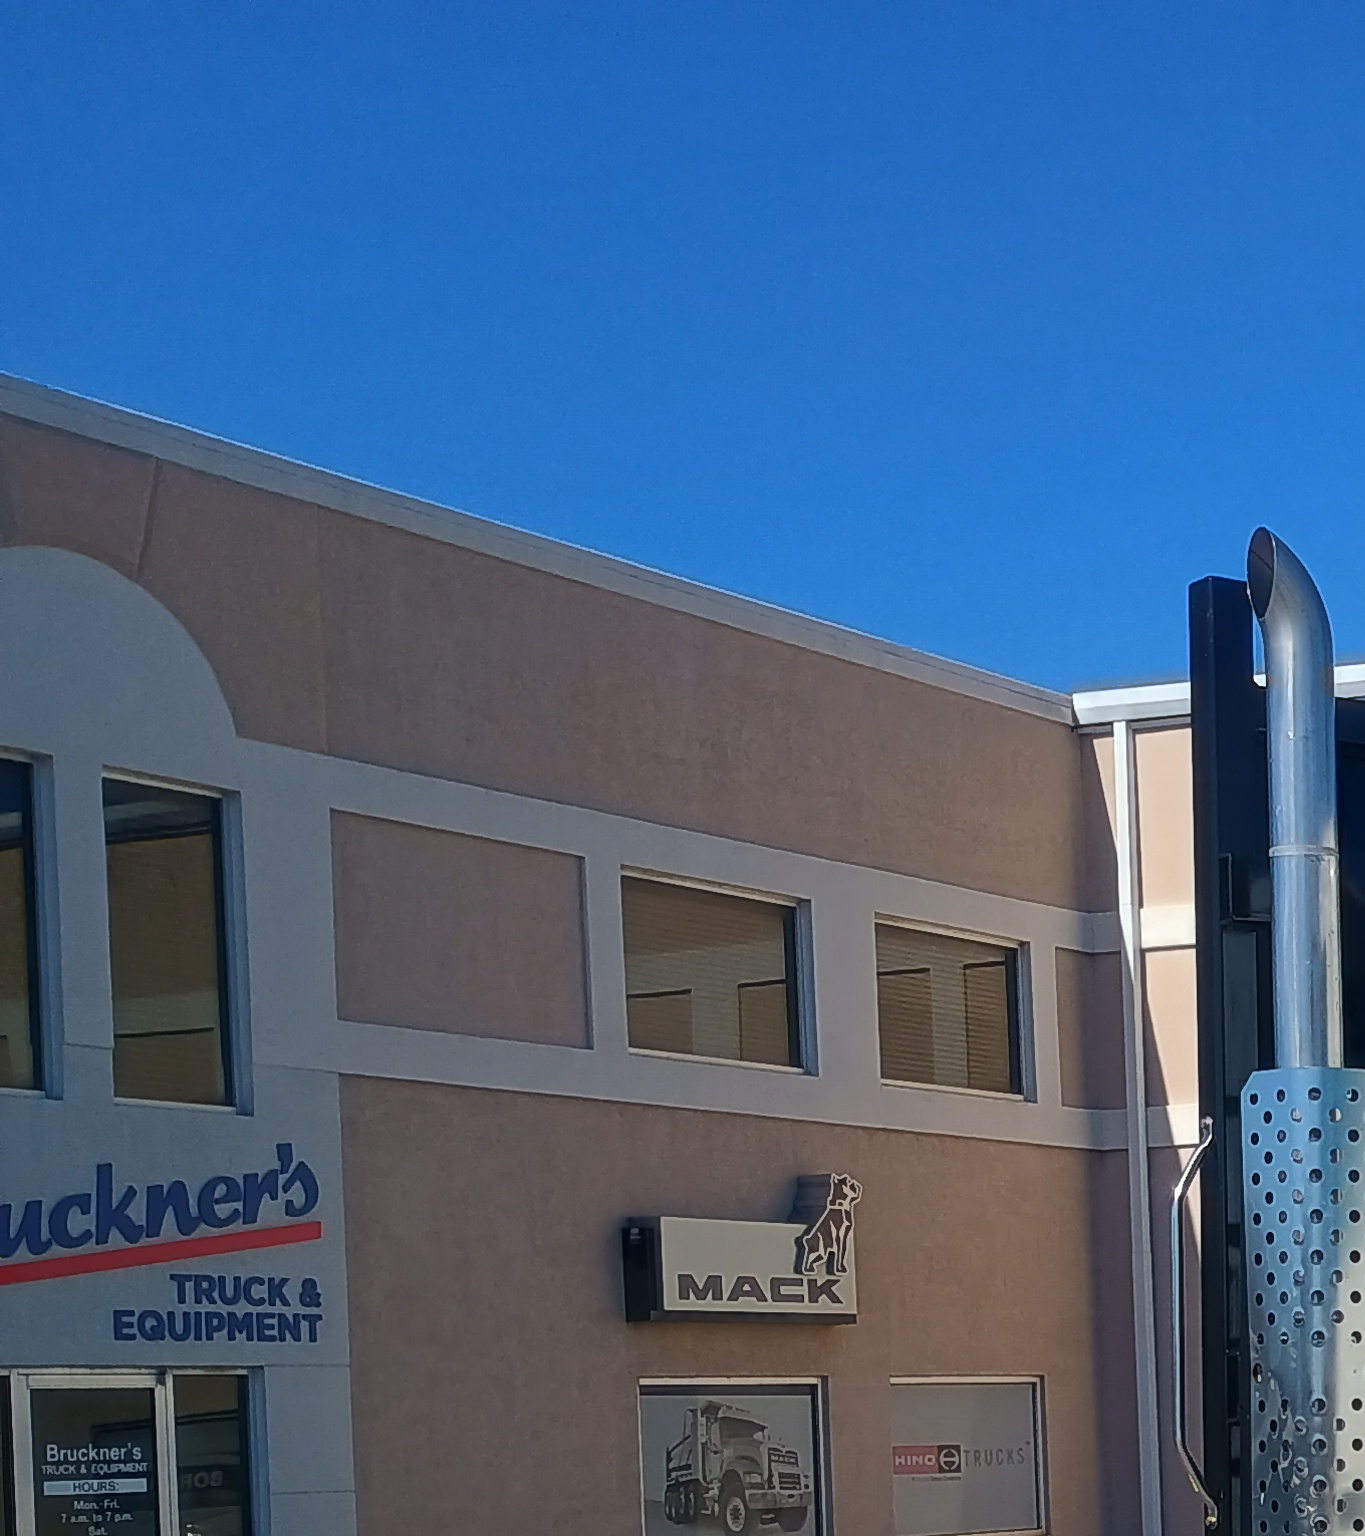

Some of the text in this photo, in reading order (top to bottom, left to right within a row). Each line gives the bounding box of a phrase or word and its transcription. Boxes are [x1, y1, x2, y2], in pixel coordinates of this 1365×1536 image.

[169, 1273, 322, 1308] TRUCK &
[677, 1273, 844, 1304] MACK
[112, 1309, 323, 1343] EQUIPMENT
[46, 1442, 142, 1462] Bruckner's
[895, 1447, 1026, 1467] HINO TRUCKS
[41, 1462, 149, 1475] TRUCK & EQUIPMENT
[72, 1480, 120, 1493] HOURS:
[105, 1511, 112, 1521] 7
